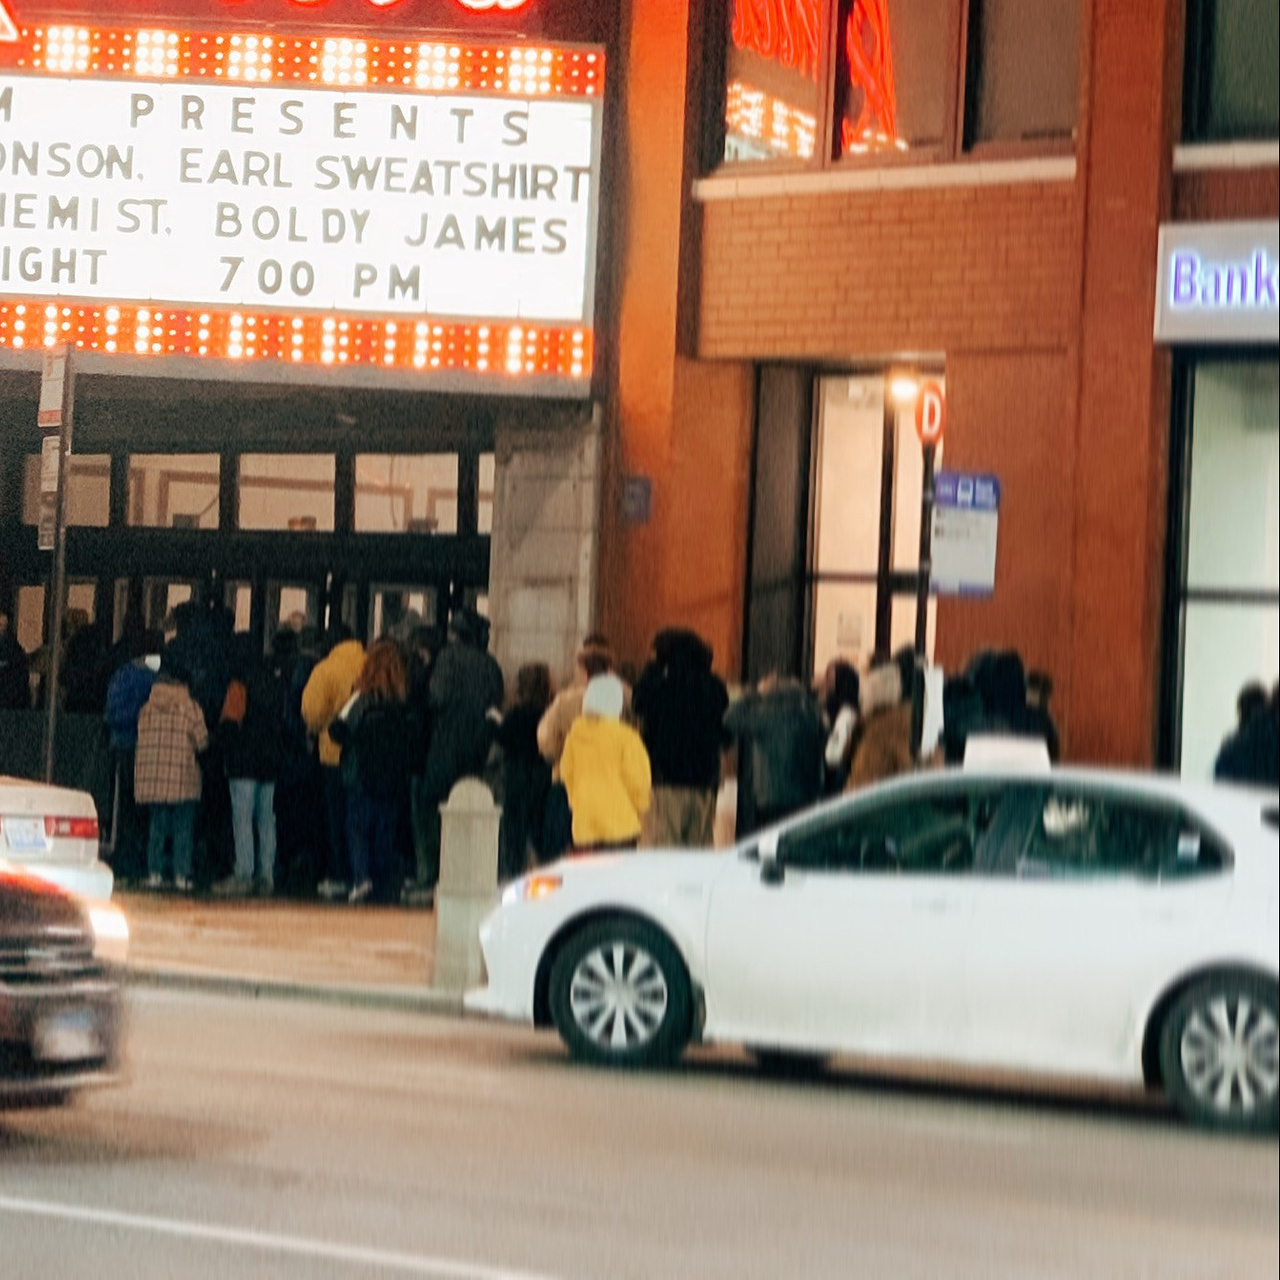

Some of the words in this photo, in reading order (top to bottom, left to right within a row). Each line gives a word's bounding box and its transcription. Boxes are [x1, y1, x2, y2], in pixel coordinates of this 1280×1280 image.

[130, 92, 530, 147] PRESENTS
[179, 147, 293, 190] EARL
[314, 154, 592, 204] SWEATSHIRT
[214, 201, 372, 245] BOLDY
[403, 213, 568, 254] JAMES
[352, 262, 422, 301] PM
[1169, 248, 1279, 309] Bank
